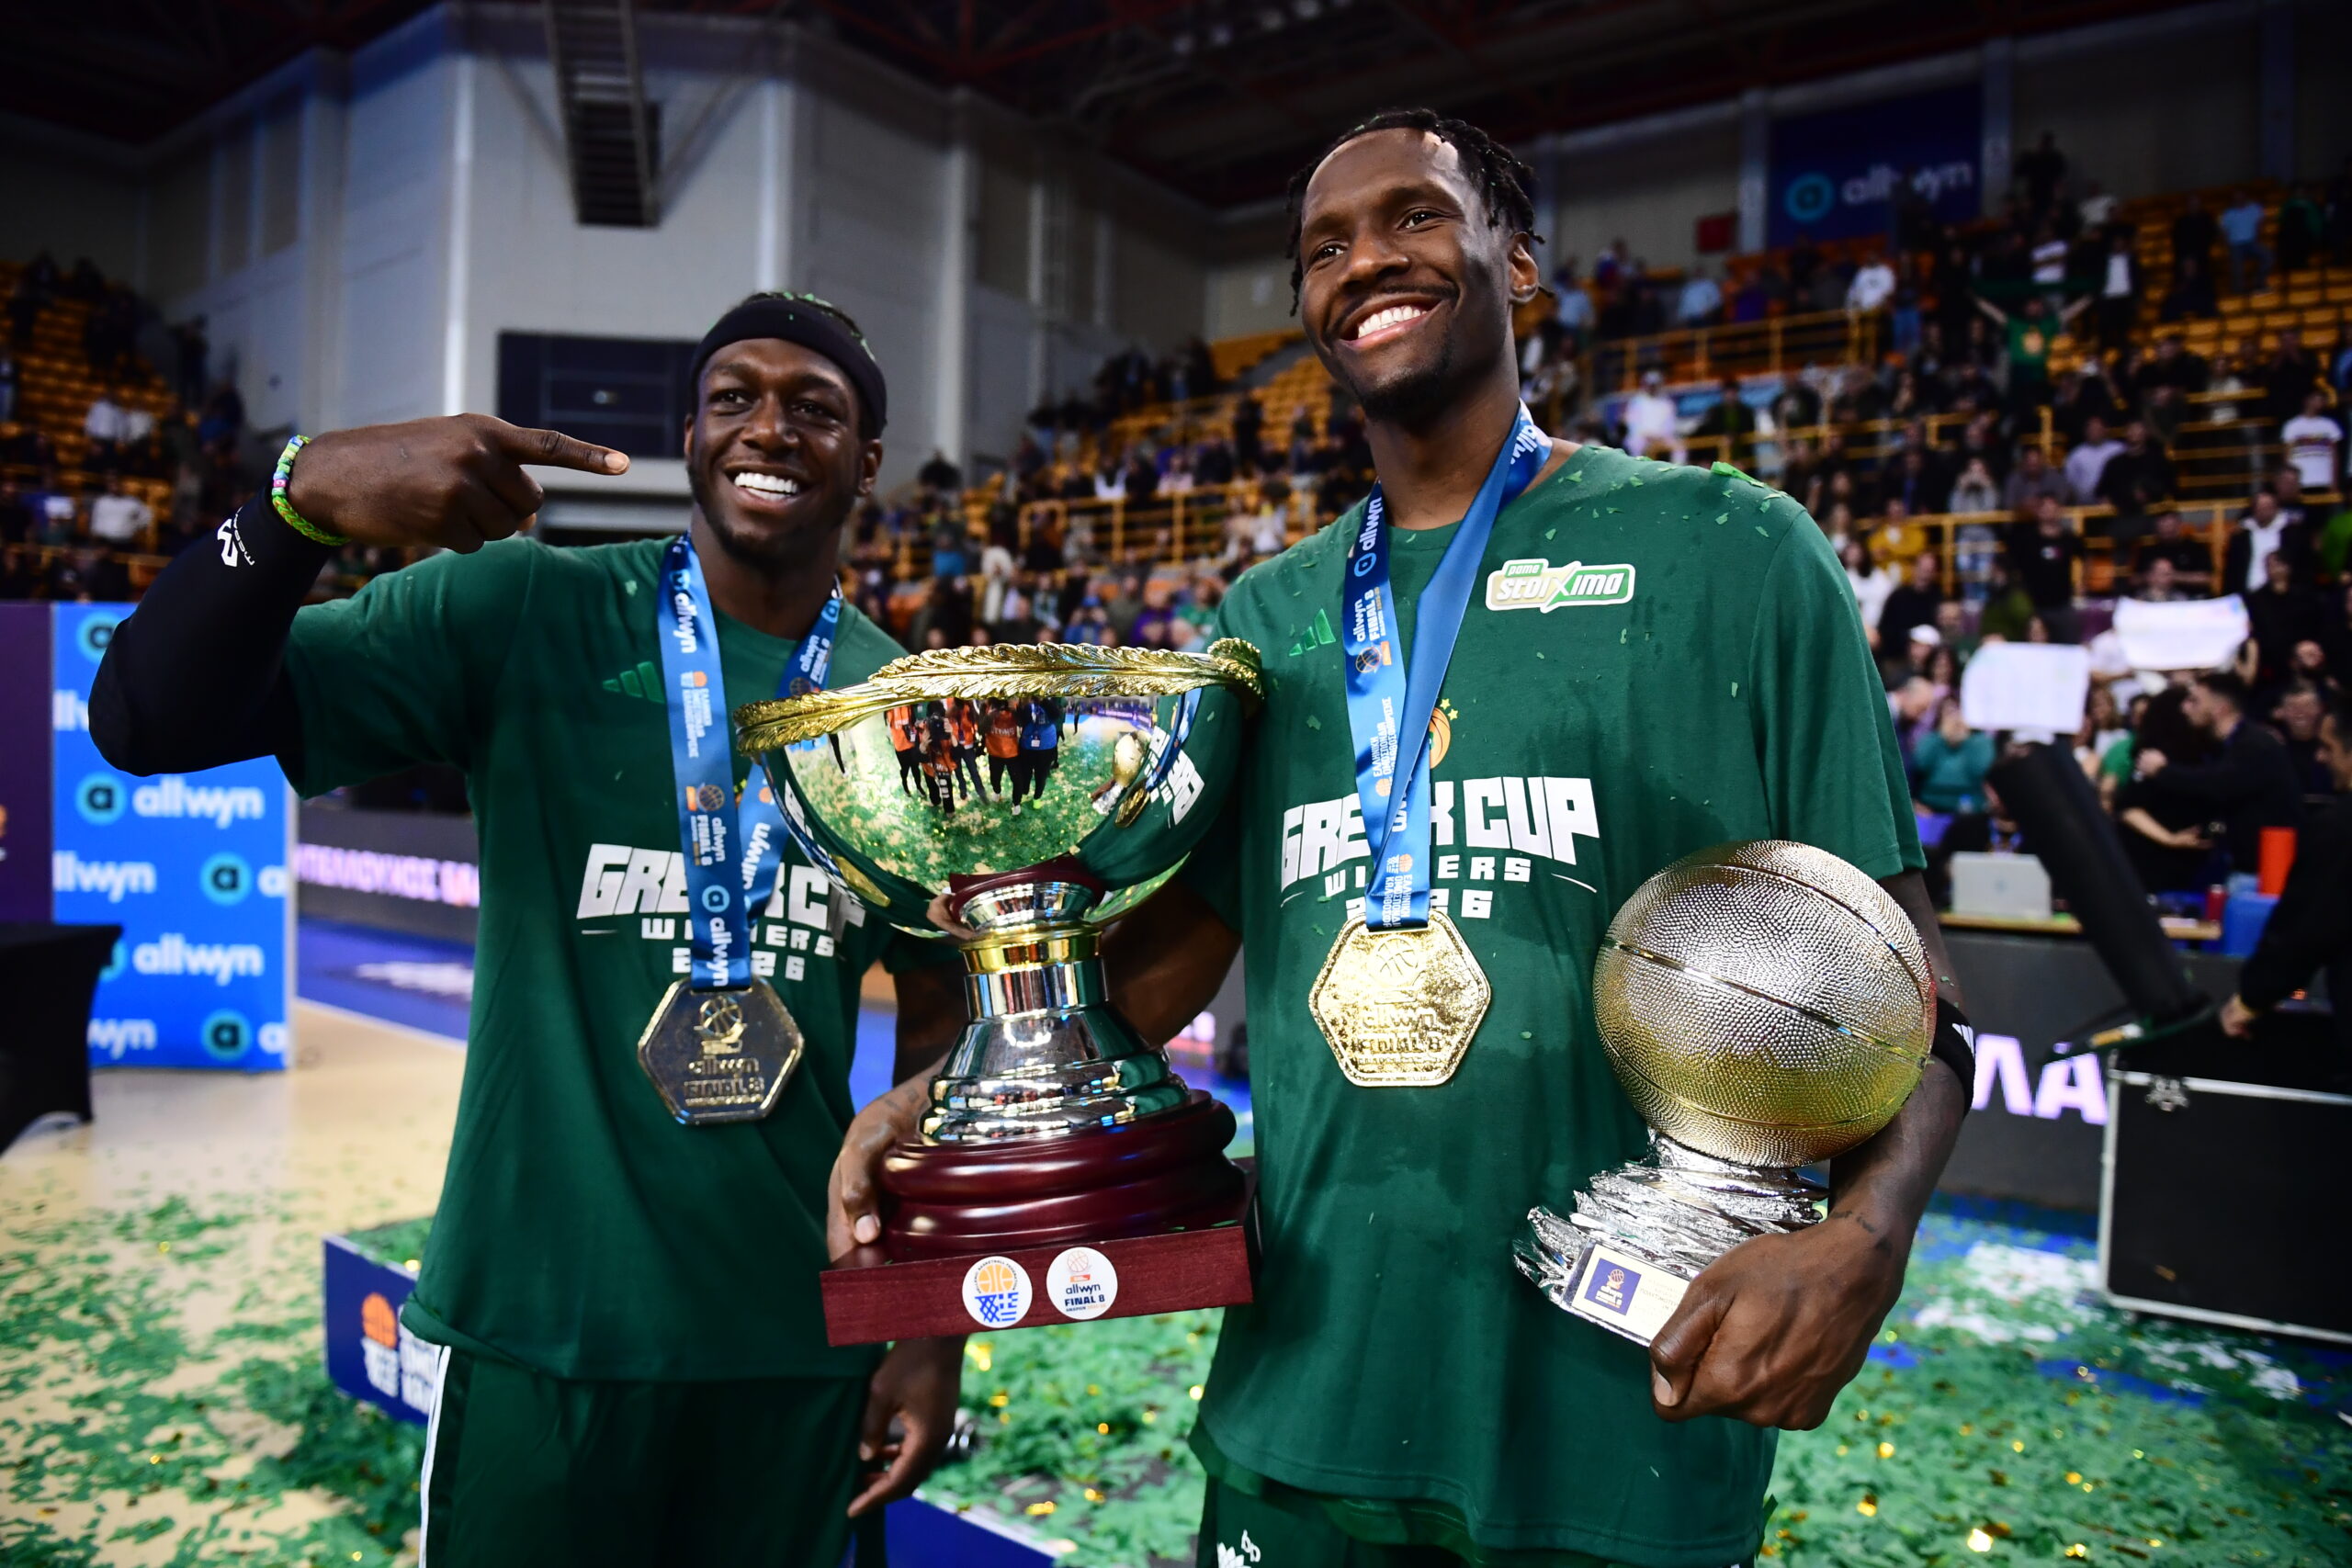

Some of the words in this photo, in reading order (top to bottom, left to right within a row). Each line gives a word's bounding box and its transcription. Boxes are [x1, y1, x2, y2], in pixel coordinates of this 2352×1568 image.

[1841, 161, 1973, 203] allyn
[1360, 497, 1383, 551] allwyn
[1508, 563, 1540, 577] pame
[1364, 589, 1375, 600] 8
[673, 592, 698, 653] allwyn
[1353, 598, 1366, 642] allwyn
[1366, 598, 1381, 641] FINAL
[132, 775, 264, 829] allwyn
[741, 822, 771, 890] allwyn
[1280, 780, 1454, 893] GREK
[1463, 776, 1600, 865] CUP
[53, 852, 156, 903] llwyn
[1324, 854, 1532, 897] WIERS
[641, 918, 835, 957] WIERS
[706, 917, 732, 987] allwyn
[132, 933, 264, 986] allwyn
[673, 947, 806, 981] 226
[1064, 1295, 1096, 1306] FINAL
[1098, 1293, 1106, 1303] 8
[1065, 1283, 1101, 1295] allwyn
